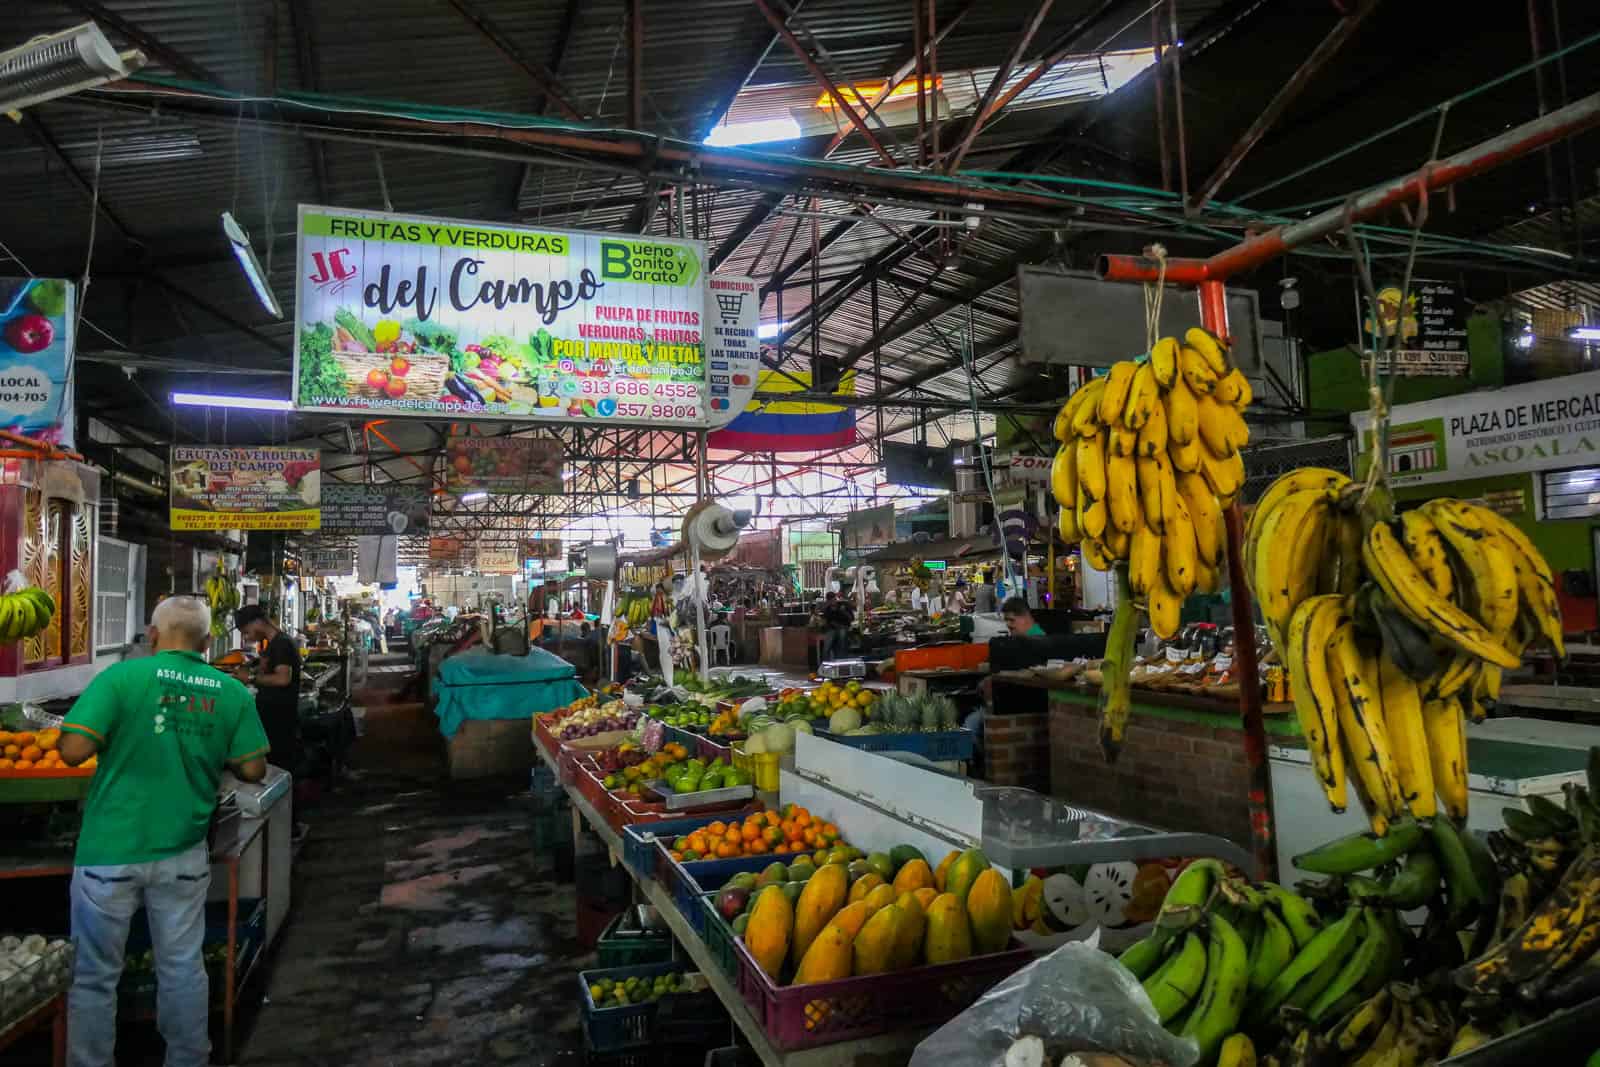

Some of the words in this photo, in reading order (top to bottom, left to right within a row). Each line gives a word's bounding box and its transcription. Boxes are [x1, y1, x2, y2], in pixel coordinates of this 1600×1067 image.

[330, 219, 420, 241] FRUTAS
[427, 227, 442, 242] Y
[446, 230, 564, 253] VERDURAS
[308, 248, 357, 285] JC
[677, 261, 687, 274] y
[363, 264, 437, 321] del
[449, 257, 605, 325] Campo
[710, 280, 755, 291] DOMICILIOS
[595, 305, 634, 321] PULPA
[636, 308, 651, 322] DE
[654, 309, 699, 326] FRUTAS
[578, 323, 645, 341] VERDURAS
[655, 328, 700, 344] FRUTAS
[714, 327, 724, 335] SE
[725, 327, 755, 337] RECIBEN
[723, 338, 747, 348] TODAS
[553, 339, 586, 358] POR
[589, 340, 641, 360] MAYOR
[645, 342, 655, 361] Y
[657, 345, 701, 363] DETAL
[711, 350, 724, 358] LAS
[726, 350, 760, 360] TARJETAS
[1, 377, 40, 387] LOCAL
[582, 380, 611, 394] 313
[615, 382, 649, 396] 686
[654, 383, 697, 397] 4552
[0, 393, 48, 402] 04-705
[617, 403, 647, 417] 557
[651, 404, 697, 418] 9804
[1451, 411, 1501, 436] PLAZA
[1505, 406, 1528, 428] DE
[177, 448, 231, 460] FRUTAS
[245, 449, 315, 461] VERDURAS
[210, 461, 237, 472] DEL
[239, 461, 284, 472] CAMPO
